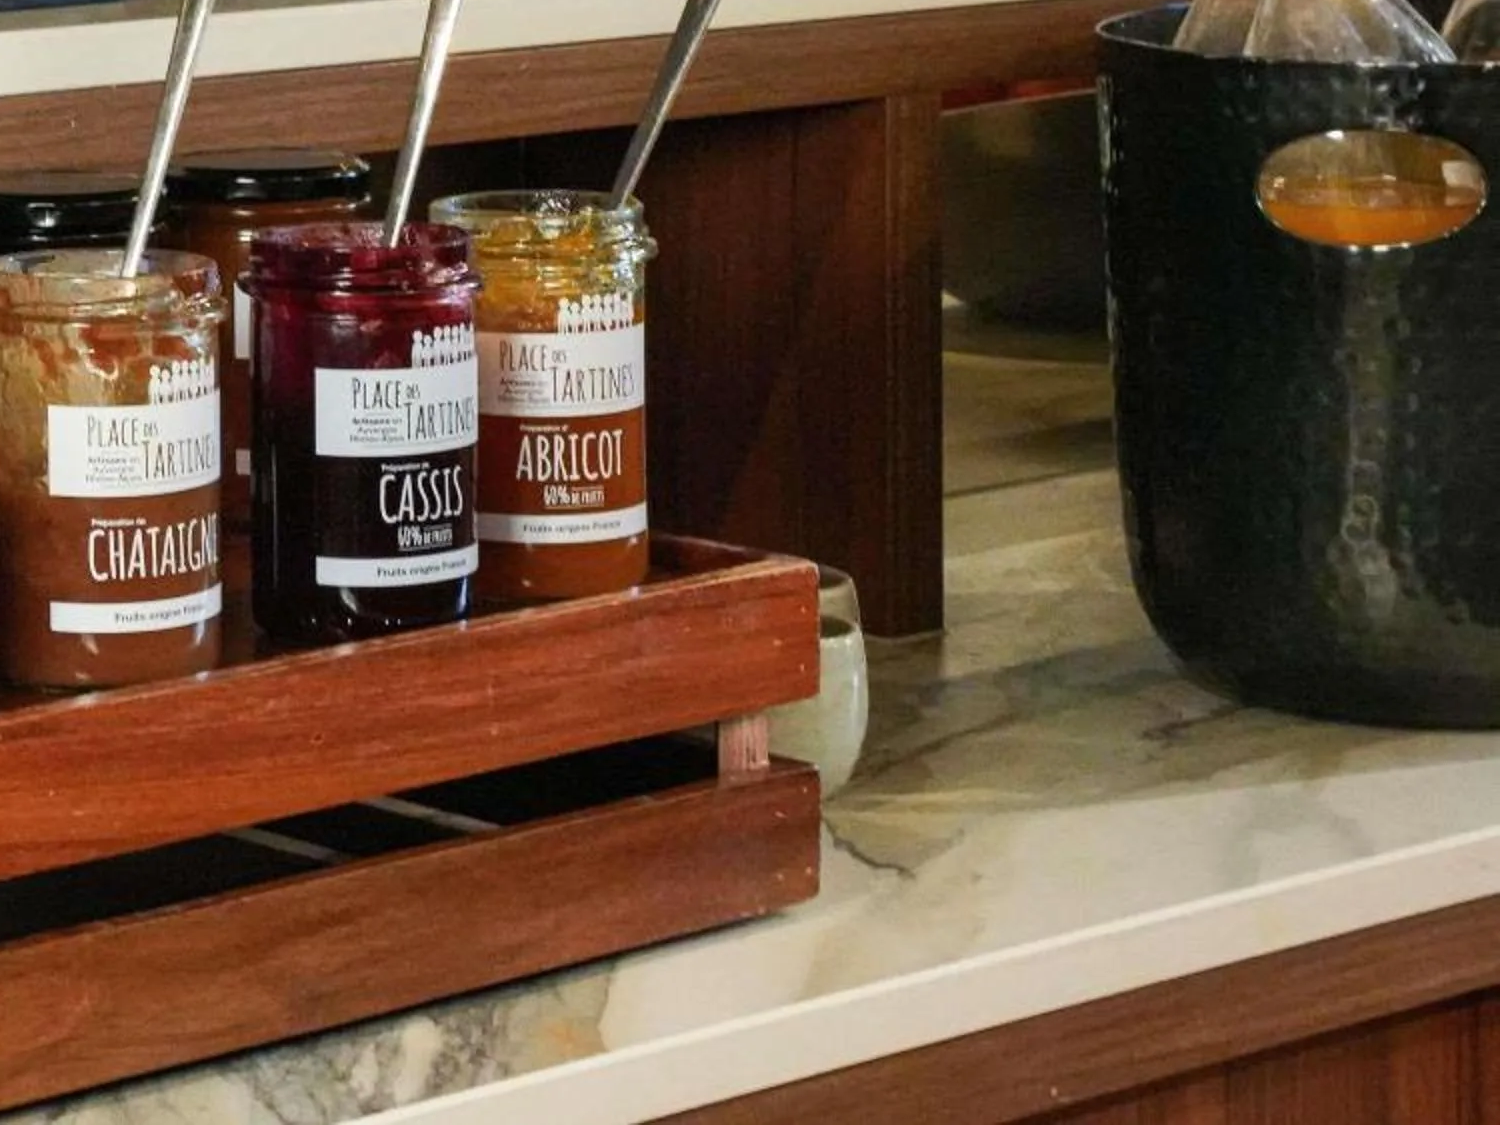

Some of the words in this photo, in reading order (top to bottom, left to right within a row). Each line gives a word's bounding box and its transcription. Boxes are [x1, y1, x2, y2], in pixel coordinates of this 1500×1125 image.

[500, 341, 548, 372] PLACE
[352, 377, 401, 411] PLACE
[87, 415, 138, 448] PLACE
[142, 434, 213, 481] TARTINE
[516, 429, 623, 482] ABRICOT
[379, 464, 463, 524] CASSIS
